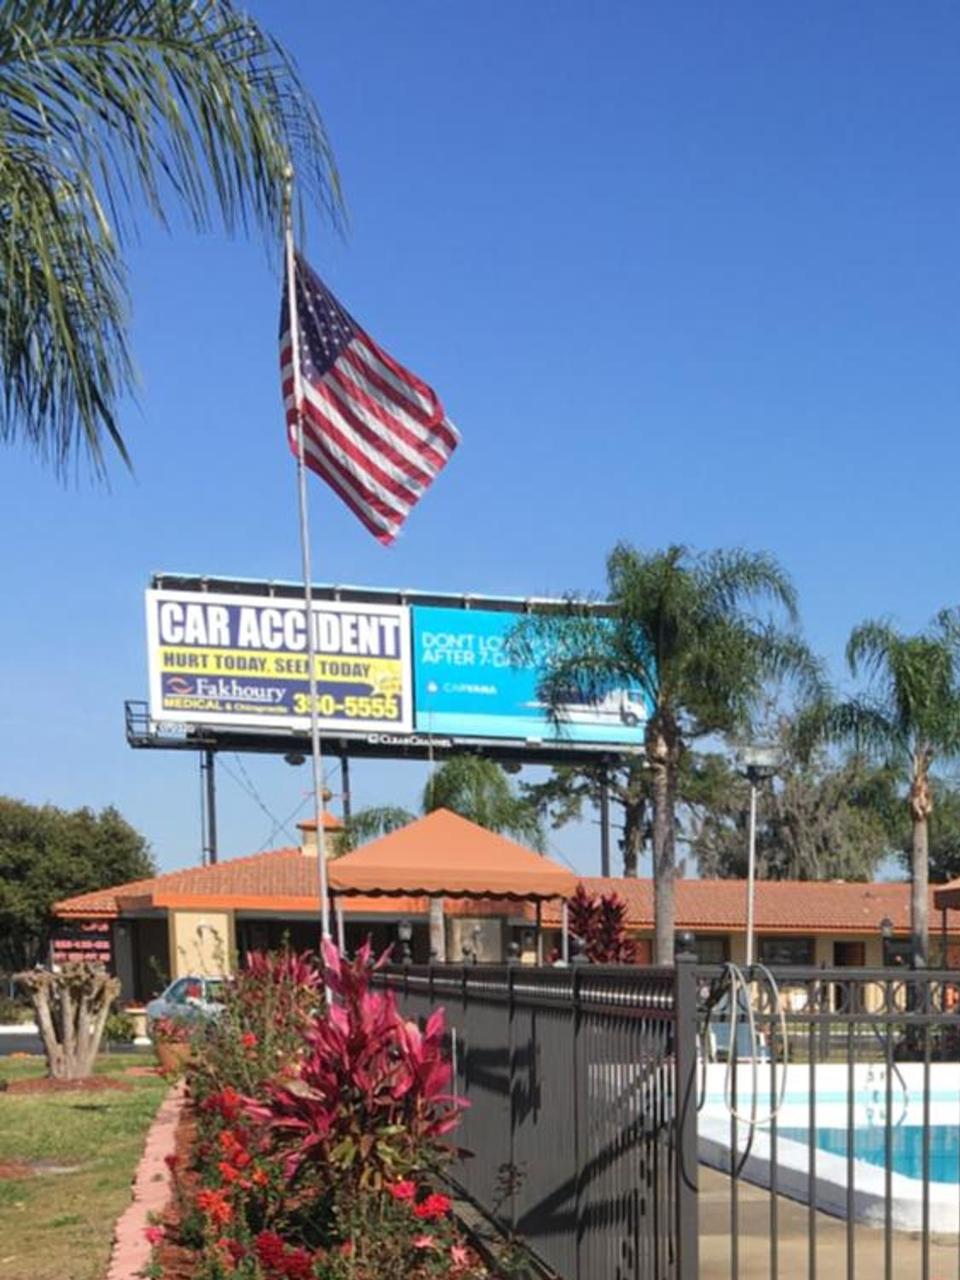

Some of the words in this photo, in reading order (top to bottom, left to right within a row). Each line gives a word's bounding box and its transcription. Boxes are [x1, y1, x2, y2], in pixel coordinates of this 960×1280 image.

[160, 602, 230, 646] CAR
[238, 606, 399, 657] ACCIDENT
[164, 651, 208, 670] HURT
[319, 661, 371, 678] TODAY
[422, 648, 475, 666] AFTER
[196, 679, 287, 703] Fakhoury
[163, 698, 221, 711] MEDICAL
